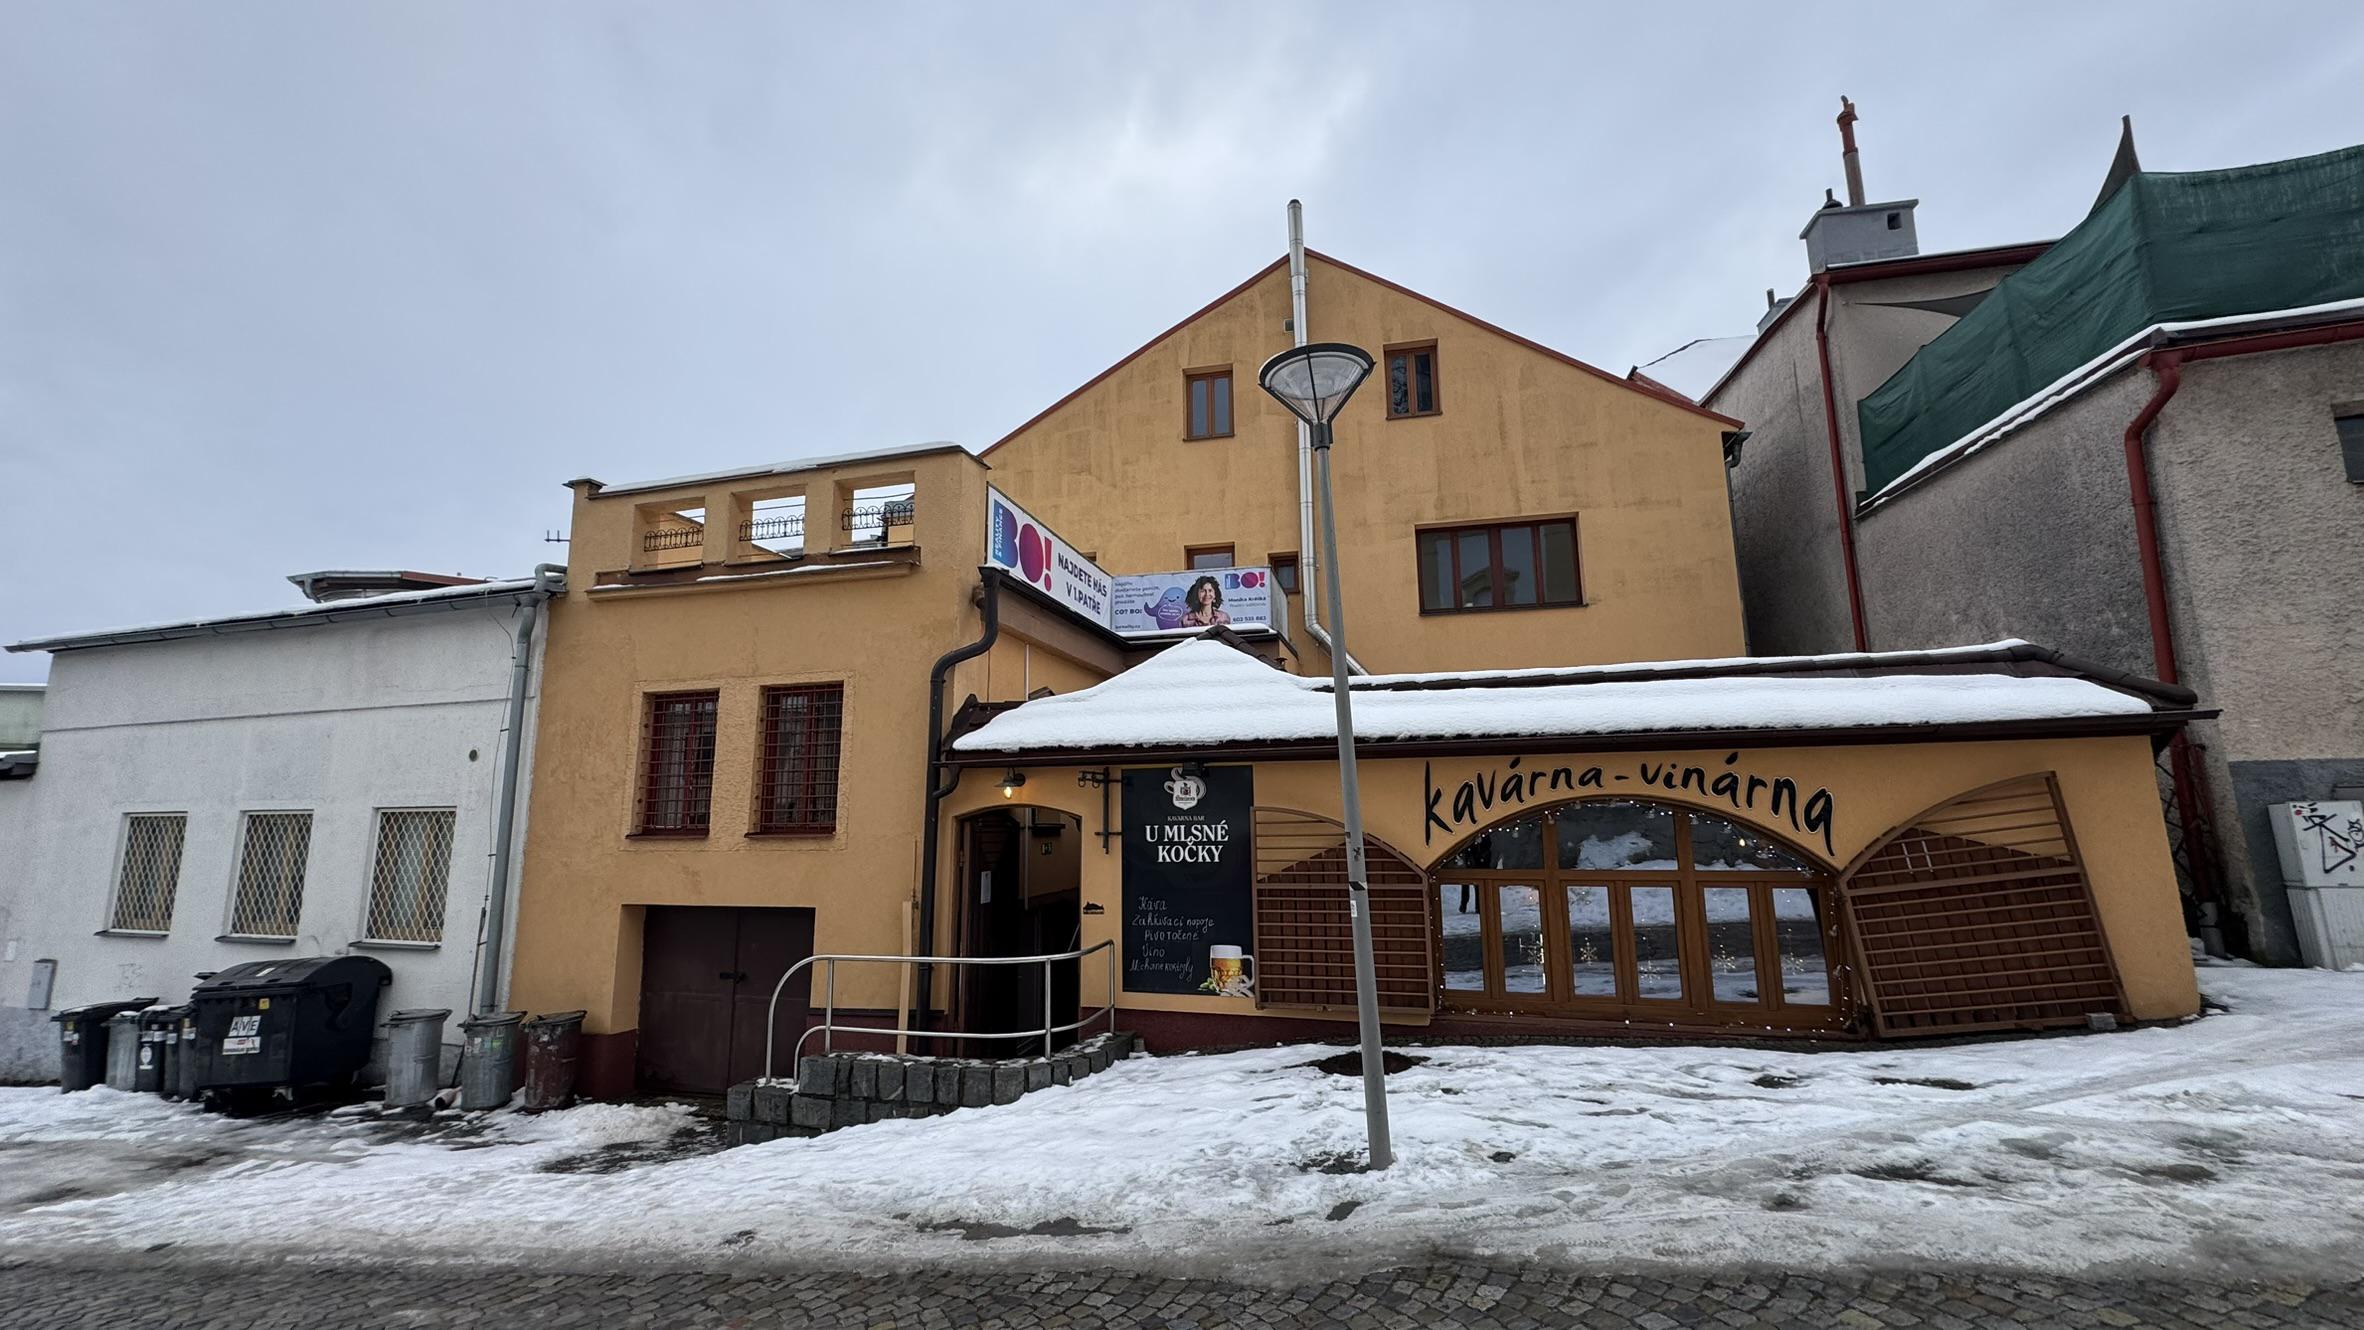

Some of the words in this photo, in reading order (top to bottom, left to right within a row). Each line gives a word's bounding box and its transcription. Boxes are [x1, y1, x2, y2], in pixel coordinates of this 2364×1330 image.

[993, 499, 1053, 592] BO!
[1058, 552, 1092, 587] NAJDETE
[1093, 577, 1107, 597] NÁS
[1225, 572, 1265, 590] BO!
[1424, 756, 1604, 848] kavárna
[1640, 752, 1836, 857] vinárna
[1145, 825, 1159, 842] U
[1164, 820, 1229, 843] MLSNÉ
[1157, 840, 1224, 863] KOČKY
[231, 1019, 259, 1032] AVE
